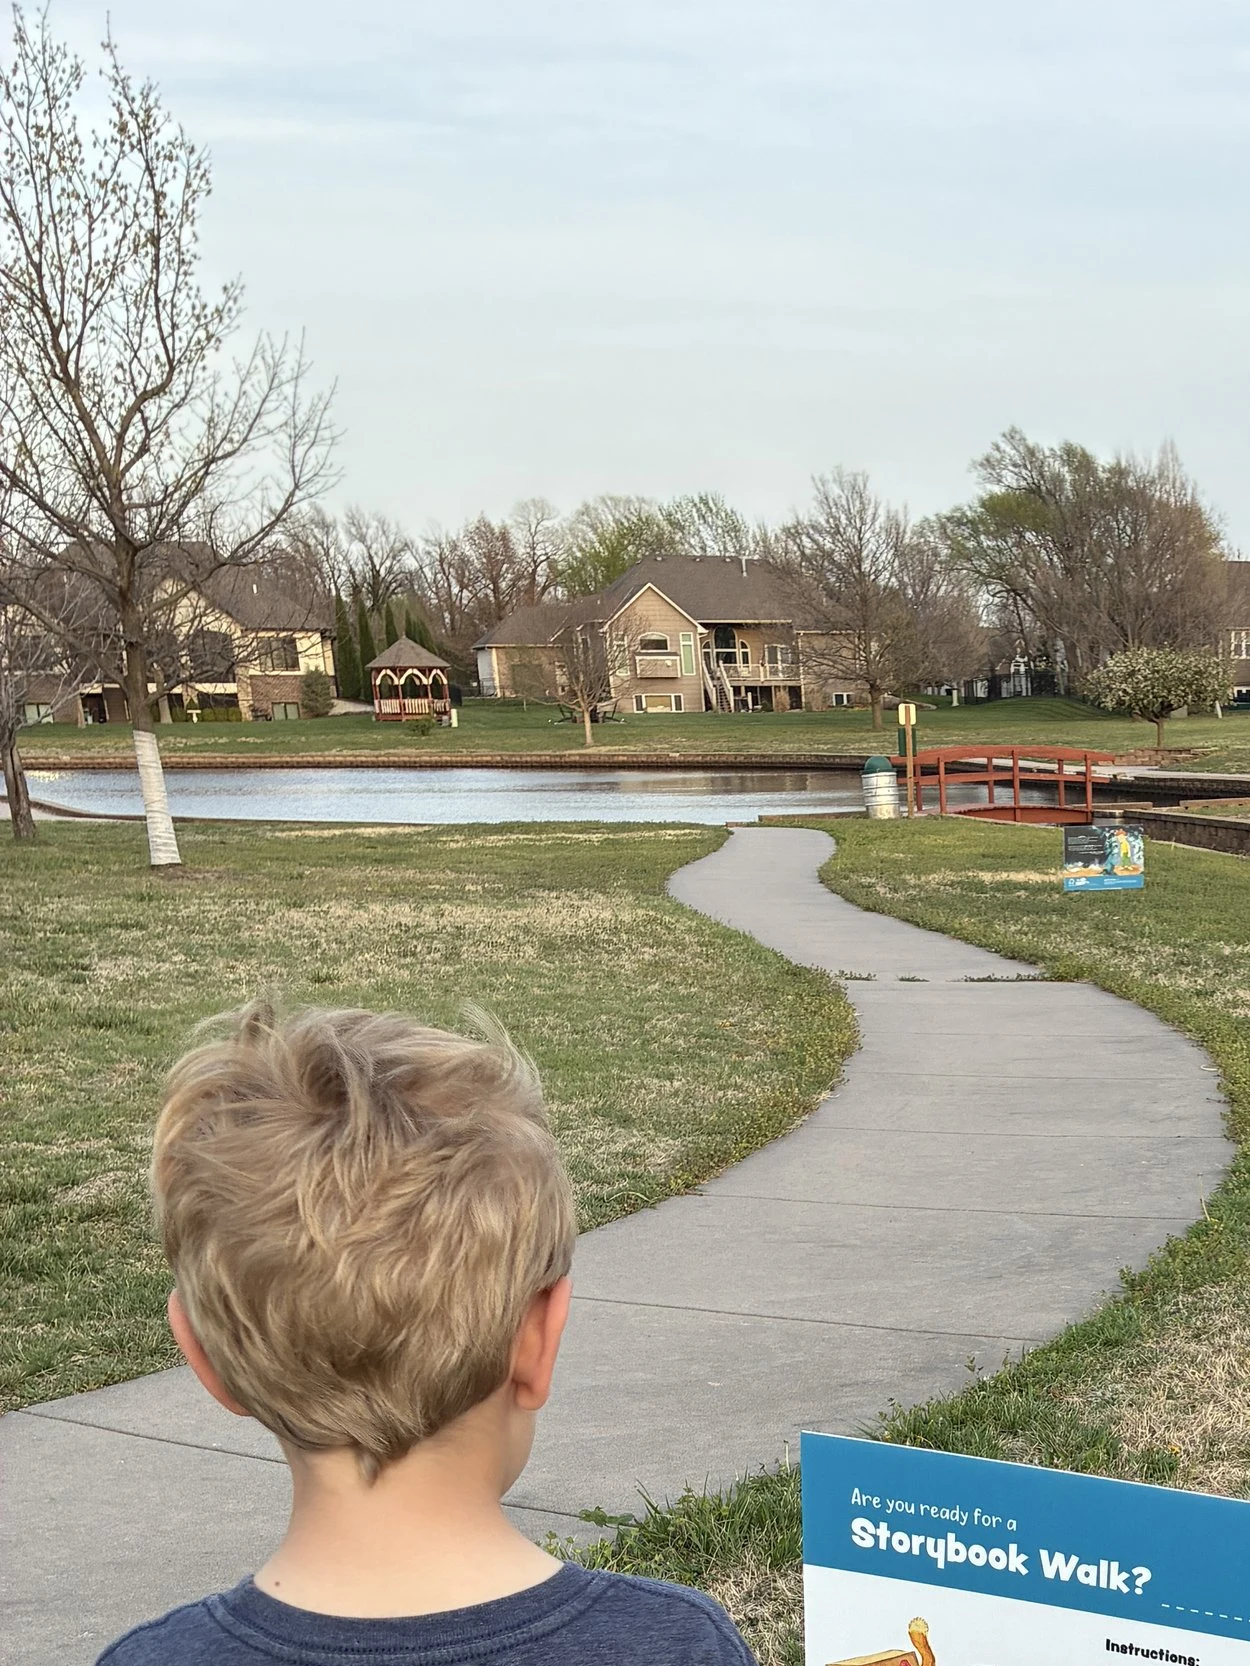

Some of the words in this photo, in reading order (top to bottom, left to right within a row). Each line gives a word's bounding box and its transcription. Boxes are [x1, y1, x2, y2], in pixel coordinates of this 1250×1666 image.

[851, 1487, 882, 1509] Are
[886, 1496, 915, 1515] you
[920, 1503, 968, 1526] ready
[973, 1508, 1002, 1528] for
[1006, 1518, 1017, 1532] a
[851, 1517, 1030, 1577] Storybook
[1039, 1548, 1152, 1595] Walk?
